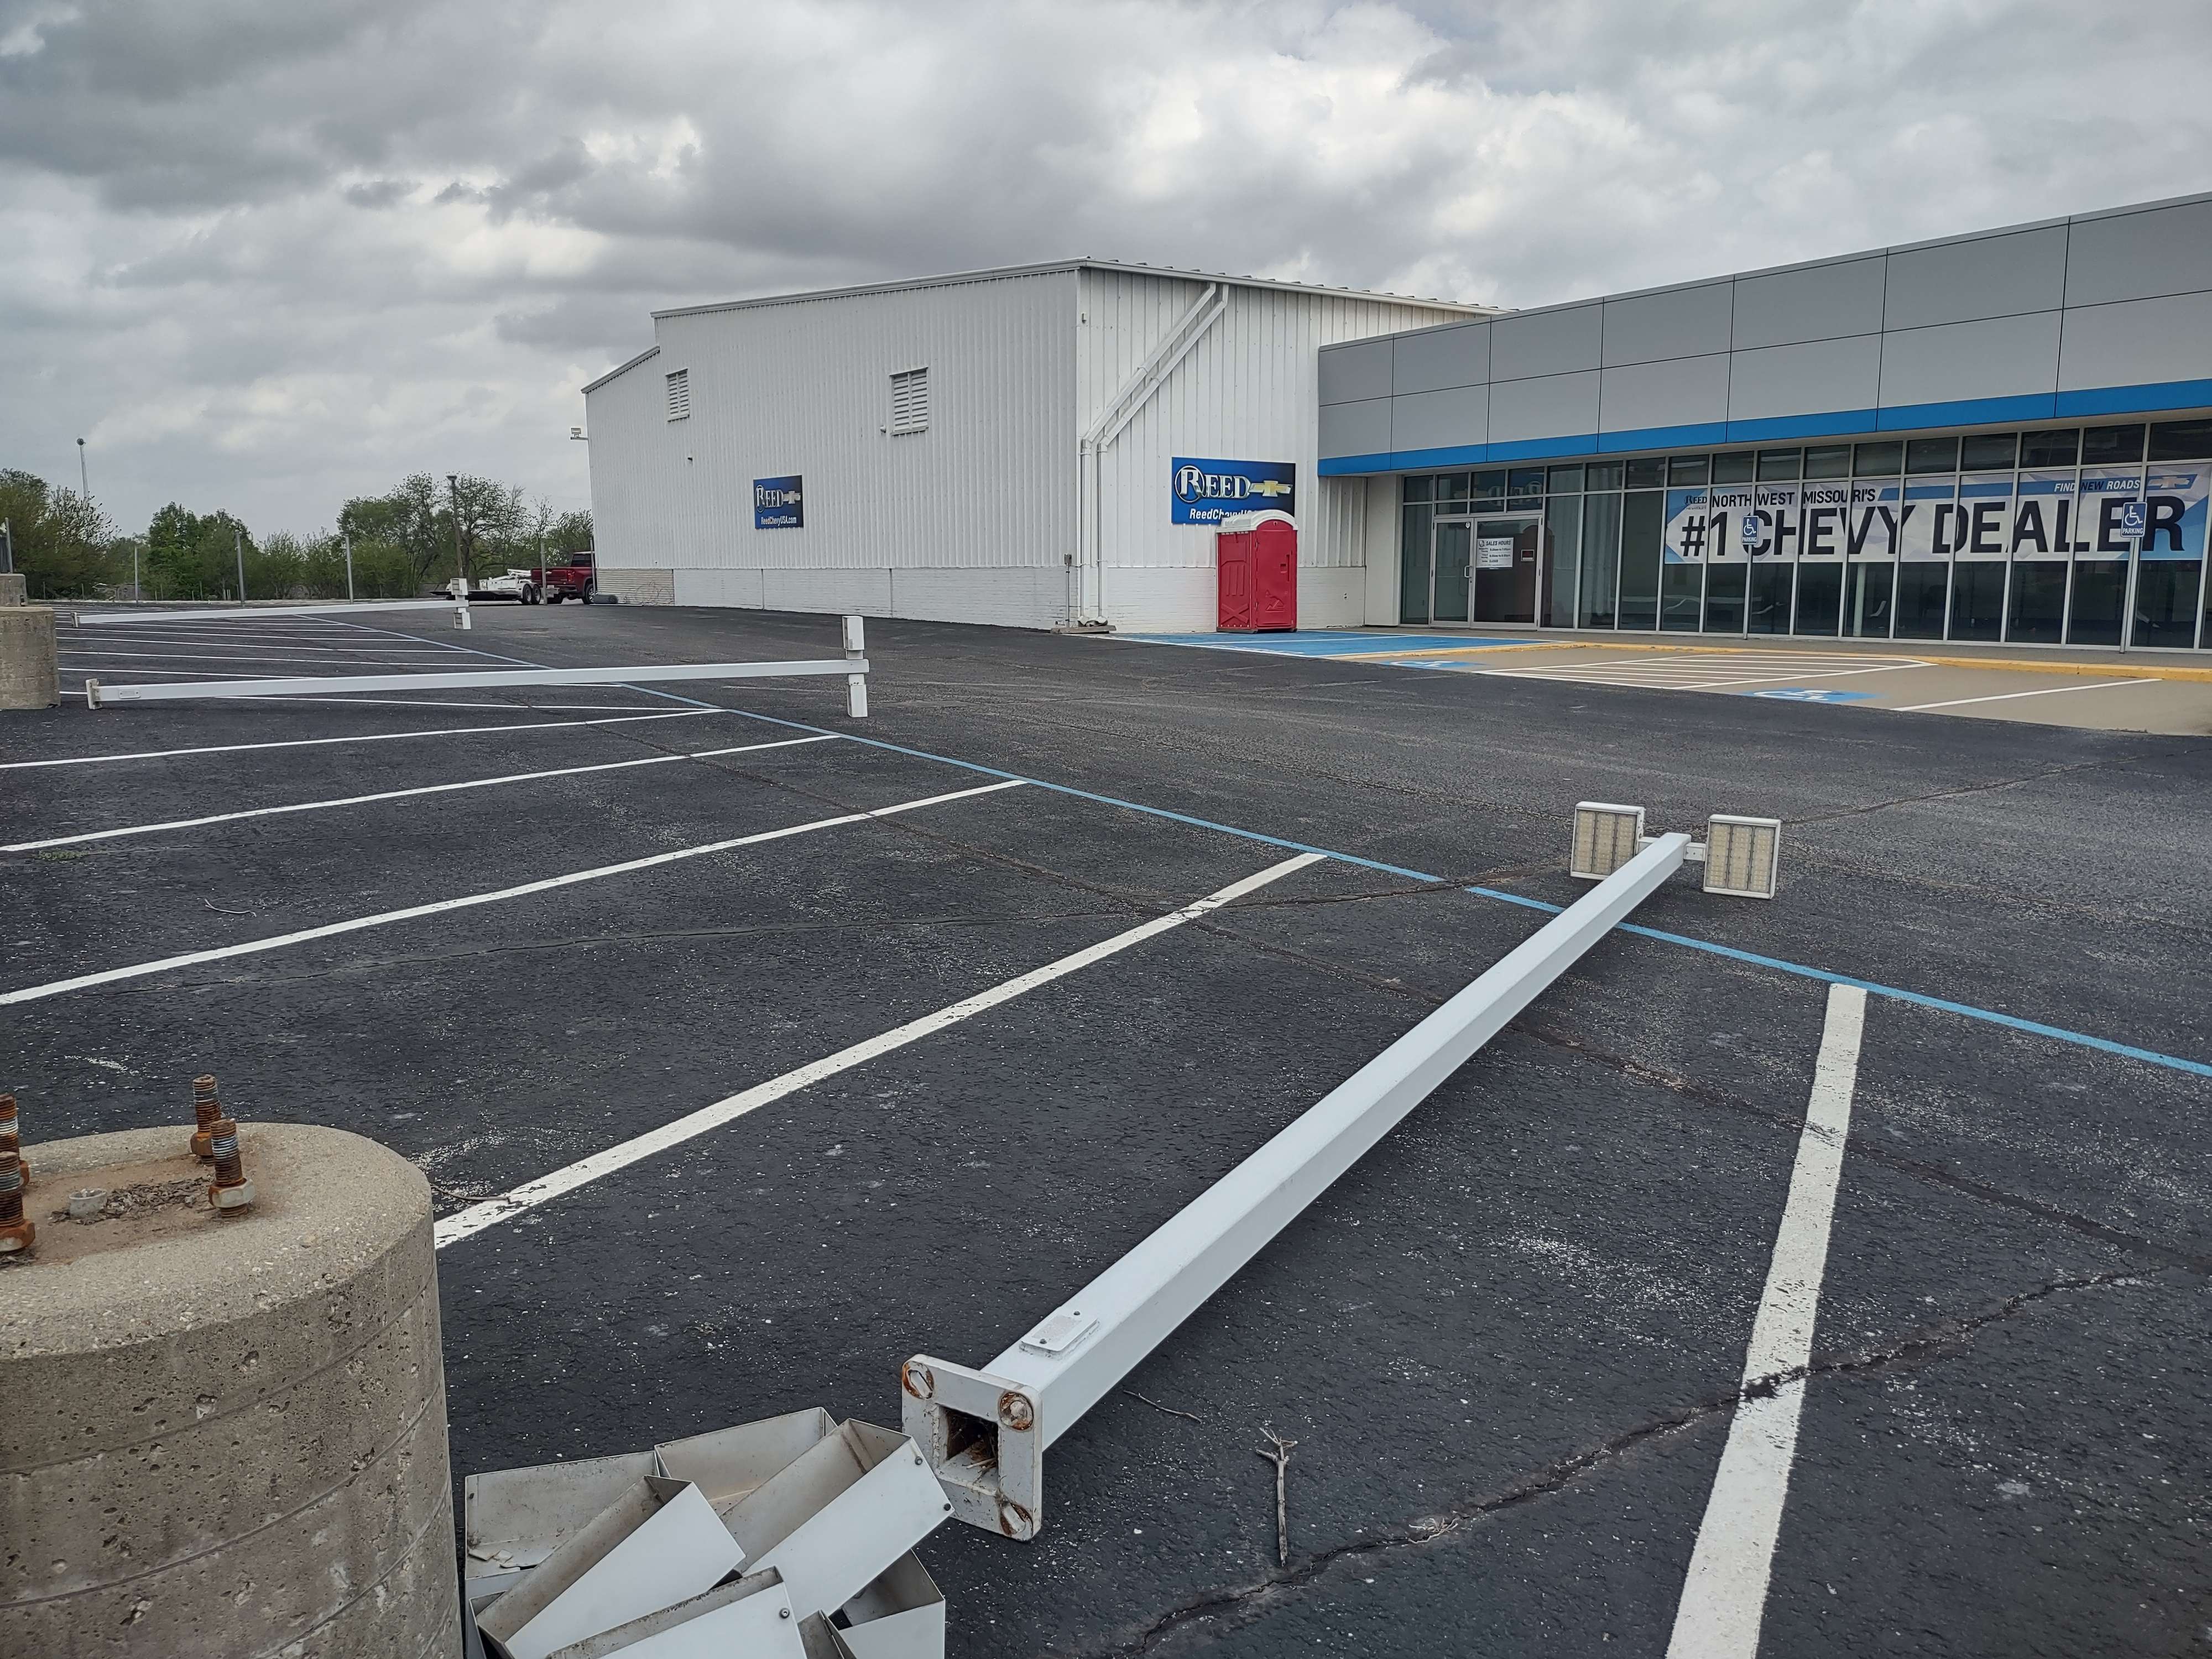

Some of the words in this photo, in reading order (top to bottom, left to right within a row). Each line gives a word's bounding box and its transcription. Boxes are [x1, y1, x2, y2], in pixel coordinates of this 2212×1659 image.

[1176, 467, 1251, 500] REED
[2054, 482, 2075, 492] FIND
[2080, 481, 2104, 491] NEW
[2106, 480, 2141, 490] ROADS
[755, 486, 784, 509] REED
[1684, 495, 1708, 505] REED
[1803, 488, 1876, 504] MISSOURI'S
[1680, 512, 1728, 556] #1
[1743, 504, 1916, 556] CHEVY
[1932, 495, 2185, 554] DEALER
